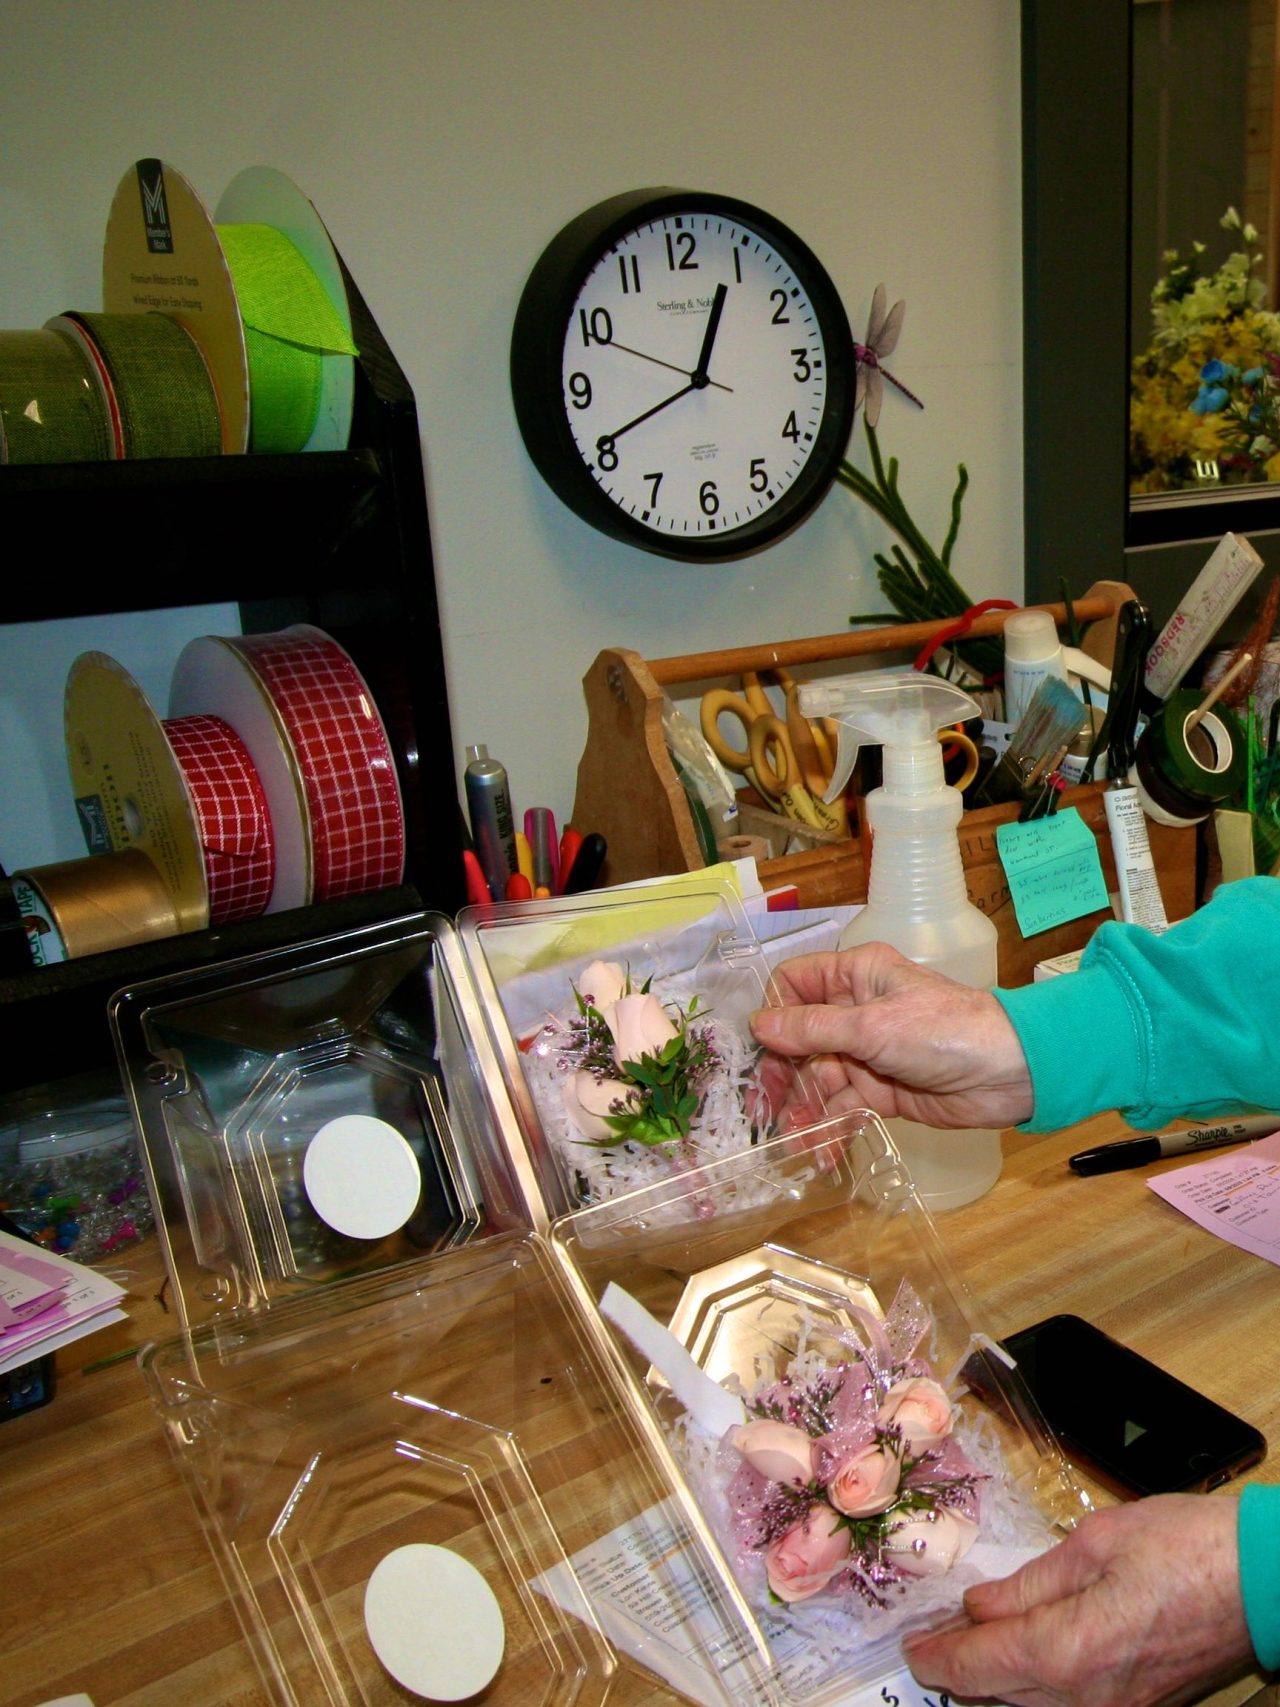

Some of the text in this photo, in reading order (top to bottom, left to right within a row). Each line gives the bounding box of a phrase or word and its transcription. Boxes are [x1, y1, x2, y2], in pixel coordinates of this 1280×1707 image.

[665, 232, 699, 271] 12
[733, 246, 742, 284] 1
[618, 254, 642, 294] 11
[656, 300, 686, 313] Sterling
[769, 288, 790, 325] 2
[579, 306, 613, 347] 10
[790, 348, 811, 383] 3
[568, 371, 593, 410] 9
[781, 410, 801, 444] 4
[596, 435, 619, 472] 8
[643, 472, 664, 509] 7
[749, 458, 769, 492] 5
[699, 481, 720, 516] 6
[17, 886, 33, 914] TAPE
[1186, 1127, 1230, 1145] Sharpie
